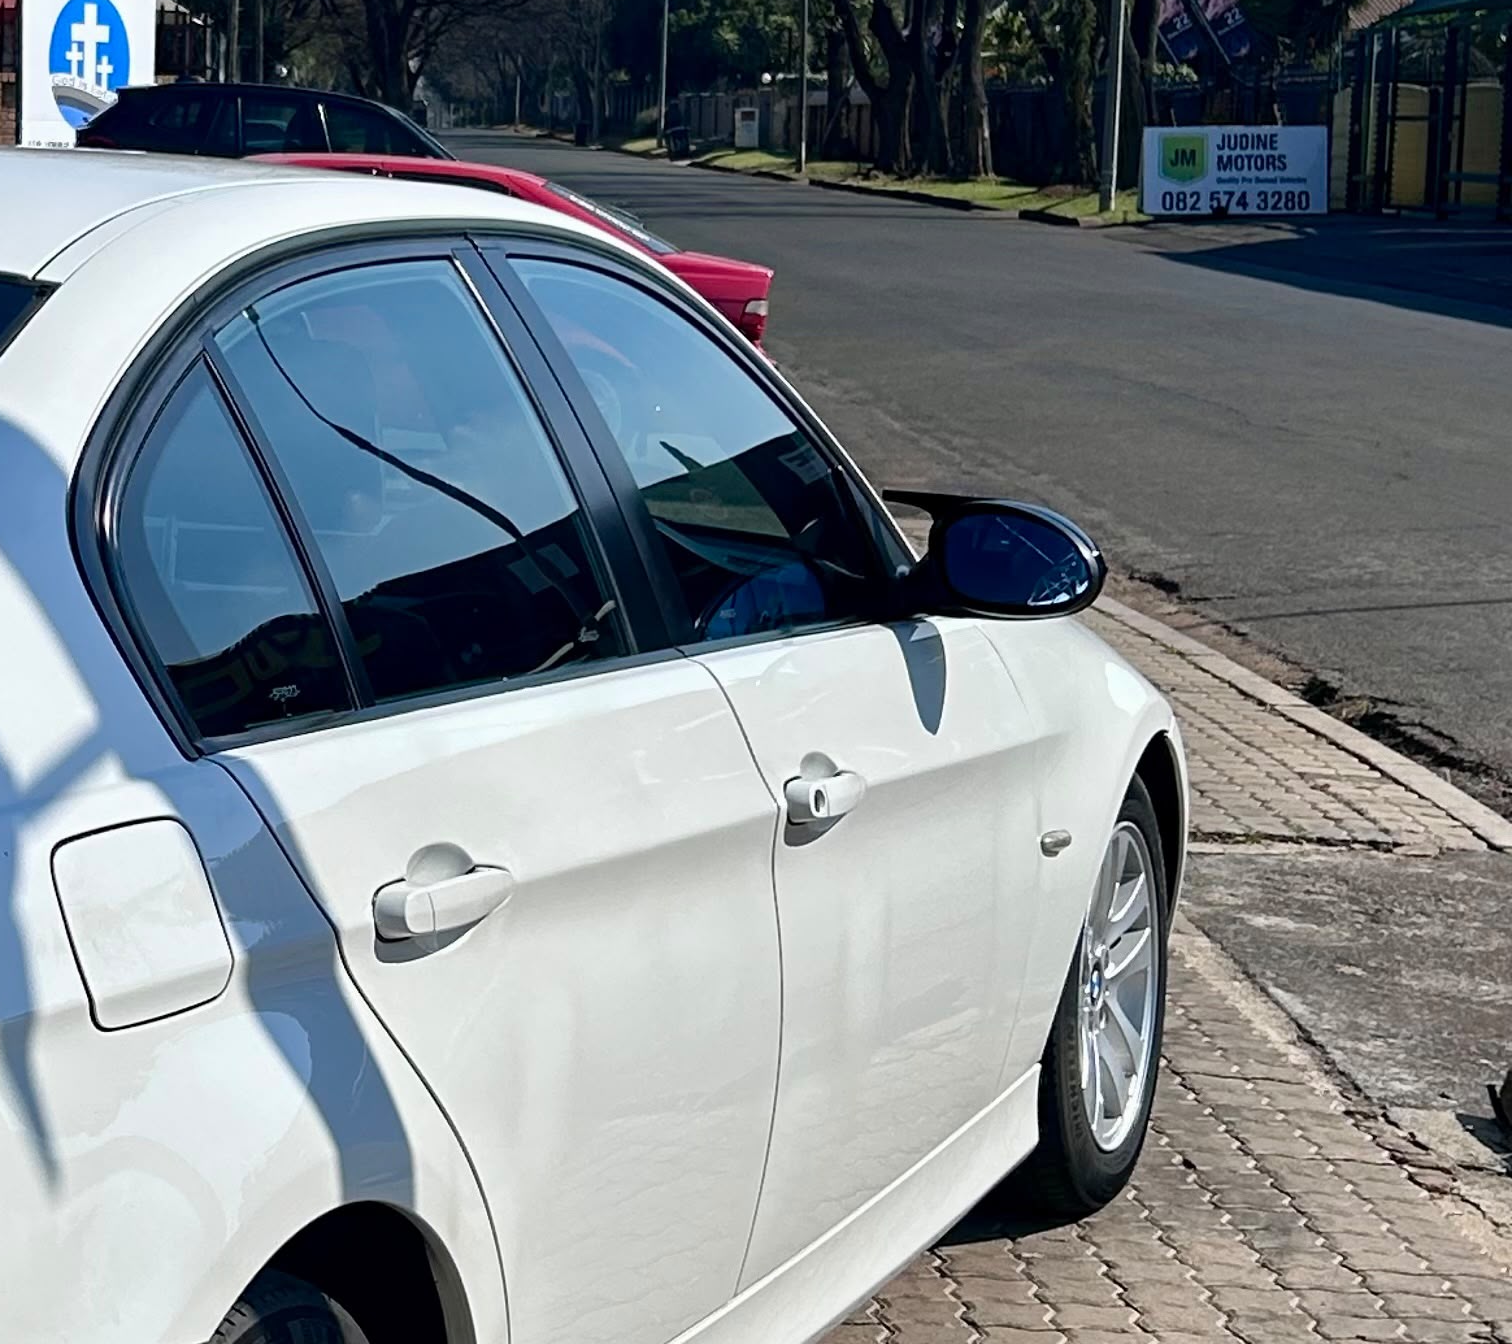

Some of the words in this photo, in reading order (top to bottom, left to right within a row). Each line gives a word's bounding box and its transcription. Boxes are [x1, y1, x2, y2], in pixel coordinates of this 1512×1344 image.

[1216, 133, 1278, 151] JUDINE
[1170, 149, 1197, 167] JM
[1216, 154, 1287, 172] MOTORS
[1161, 190, 1201, 211] 082
[1209, 190, 1249, 211] 574
[1256, 190, 1310, 211] 3280
